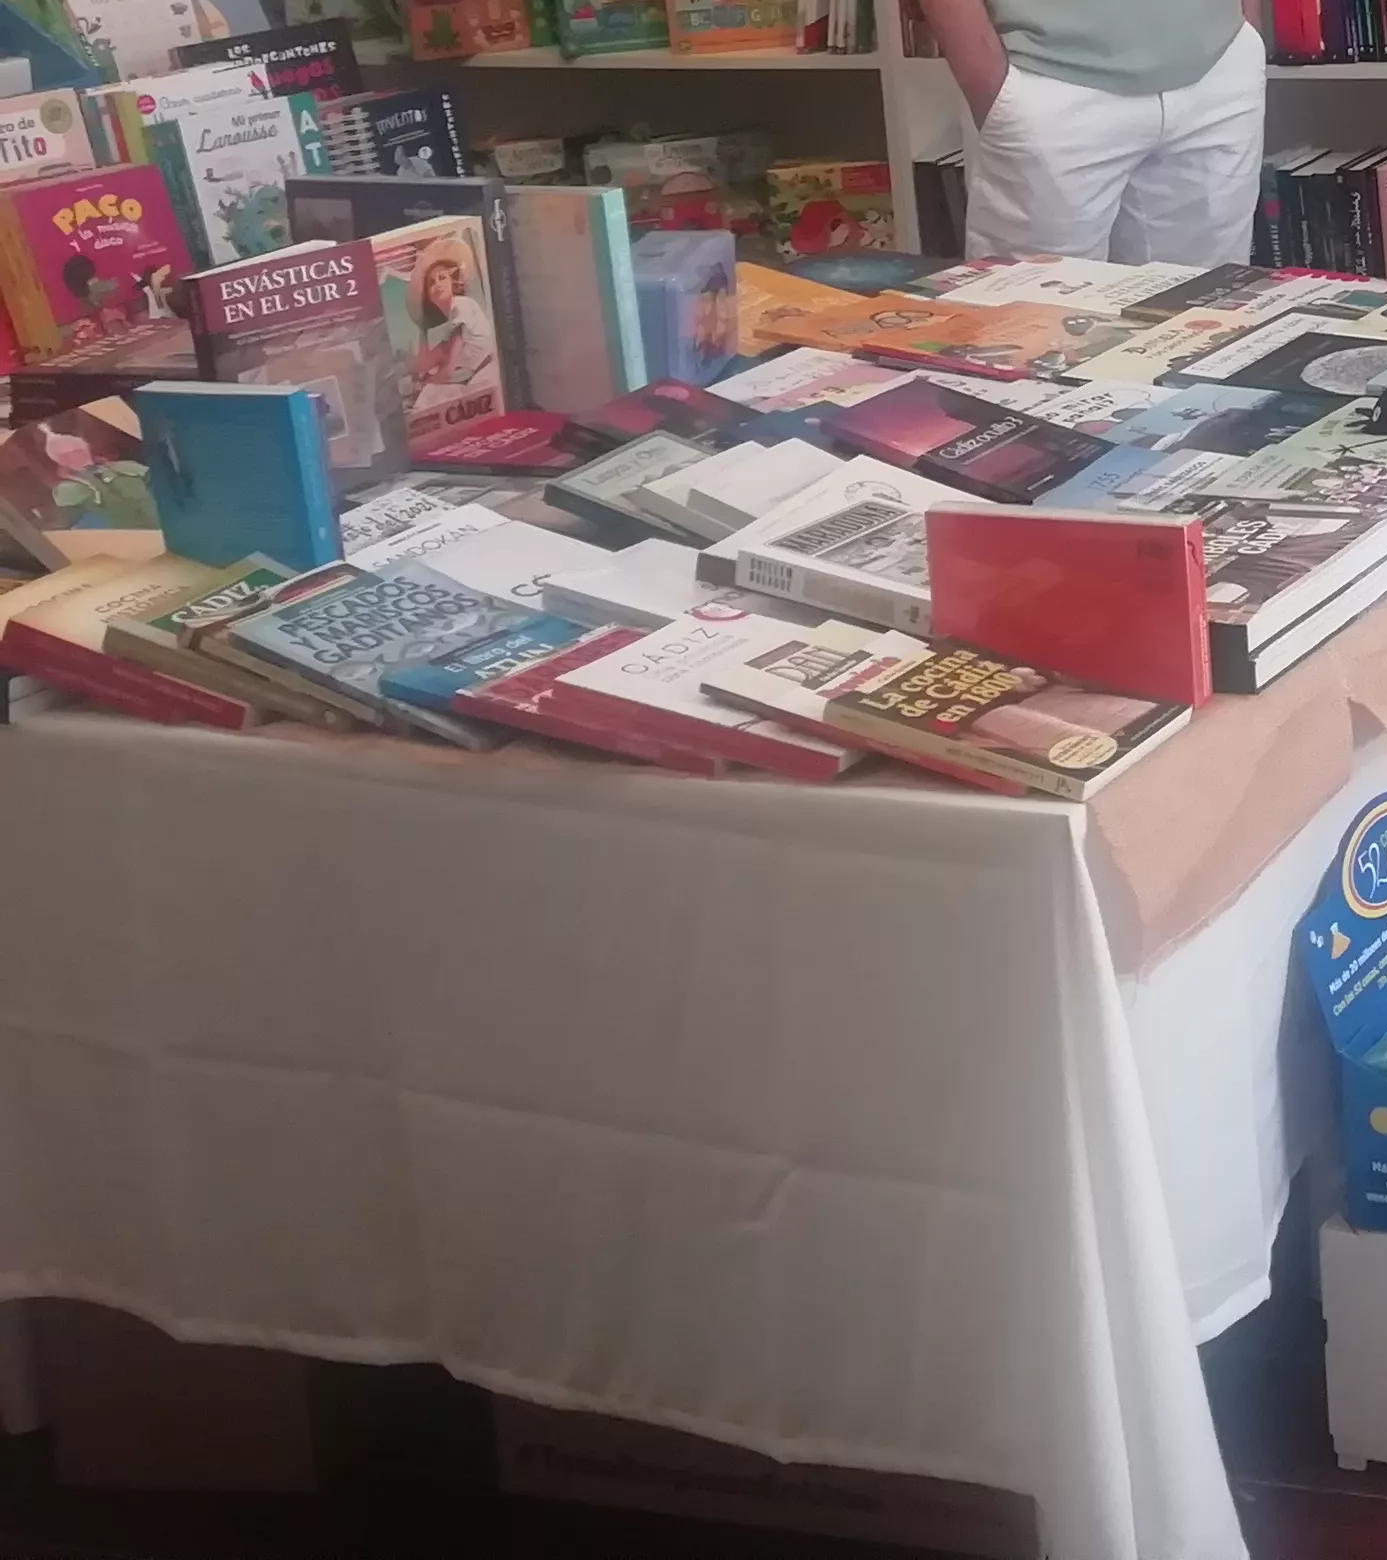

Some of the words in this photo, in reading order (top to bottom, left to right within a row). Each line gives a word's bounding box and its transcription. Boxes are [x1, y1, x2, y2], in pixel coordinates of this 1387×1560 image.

[52, 193, 143, 236] PACO
[220, 255, 355, 301] ESVÁSTICAS
[223, 301, 256, 325] EN
[259, 295, 290, 316] EL
[293, 285, 340, 309] SUR
[346, 280, 359, 297] 2
[444, 393, 495, 425] CÁDIZ
[277, 575, 419, 639] PESCADOS
[290, 630, 318, 650] Y
[314, 583, 452, 645] MARISCOS
[312, 591, 481, 665] GADITANOS
[858, 688, 908, 712] La
[901, 648, 979, 695] cocina
[900, 695, 940, 720] de
[927, 658, 1007, 700] Cádiz
[935, 703, 970, 725] en
[958, 669, 1025, 715] 1800
